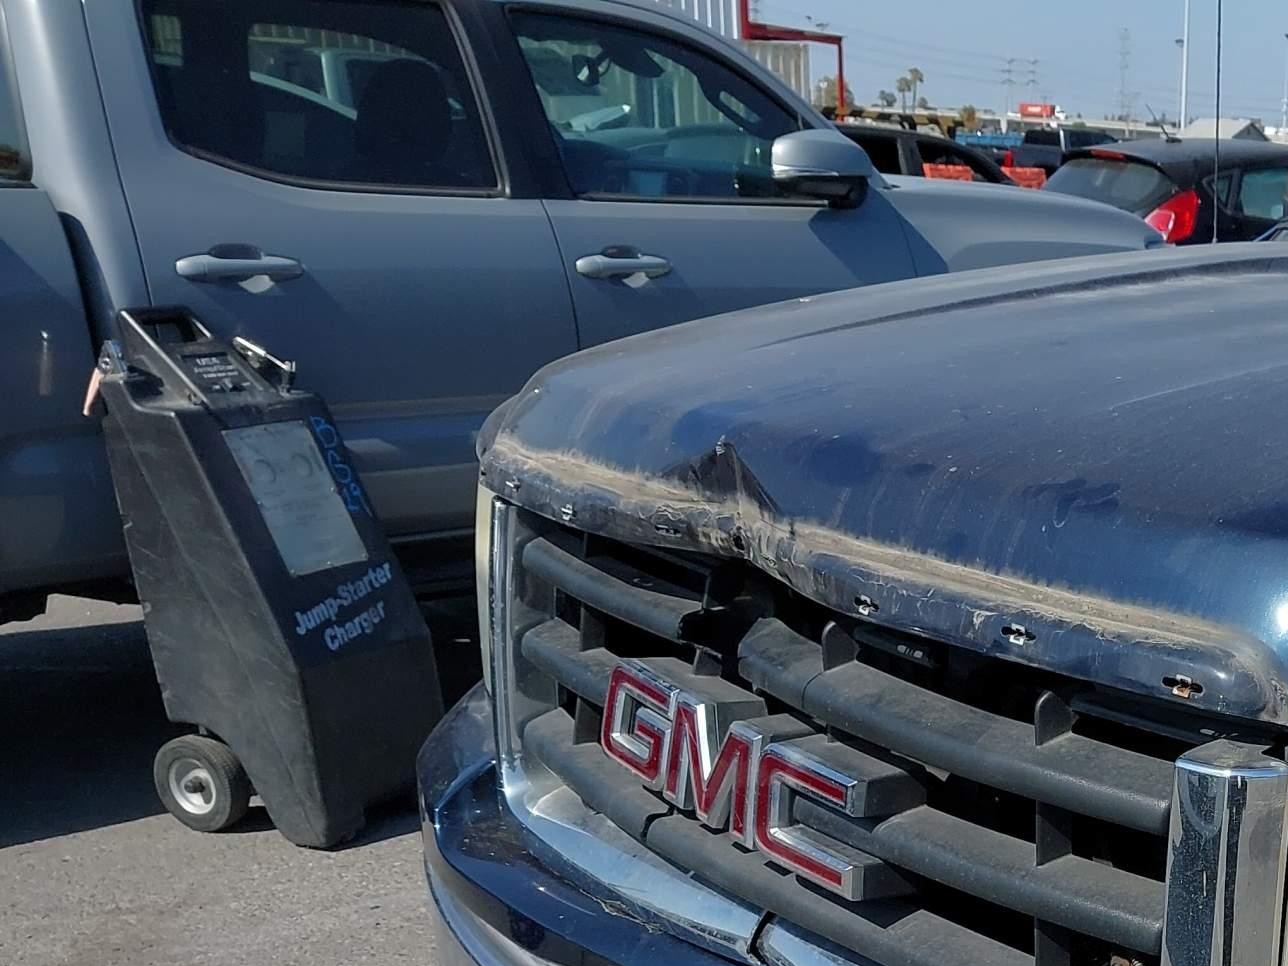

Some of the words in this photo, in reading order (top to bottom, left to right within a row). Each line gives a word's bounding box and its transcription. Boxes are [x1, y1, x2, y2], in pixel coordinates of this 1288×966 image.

[295, 562, 392, 635] Jump-Starter
[324, 600, 385, 651] Charger
[601, 659, 865, 901] GMC
